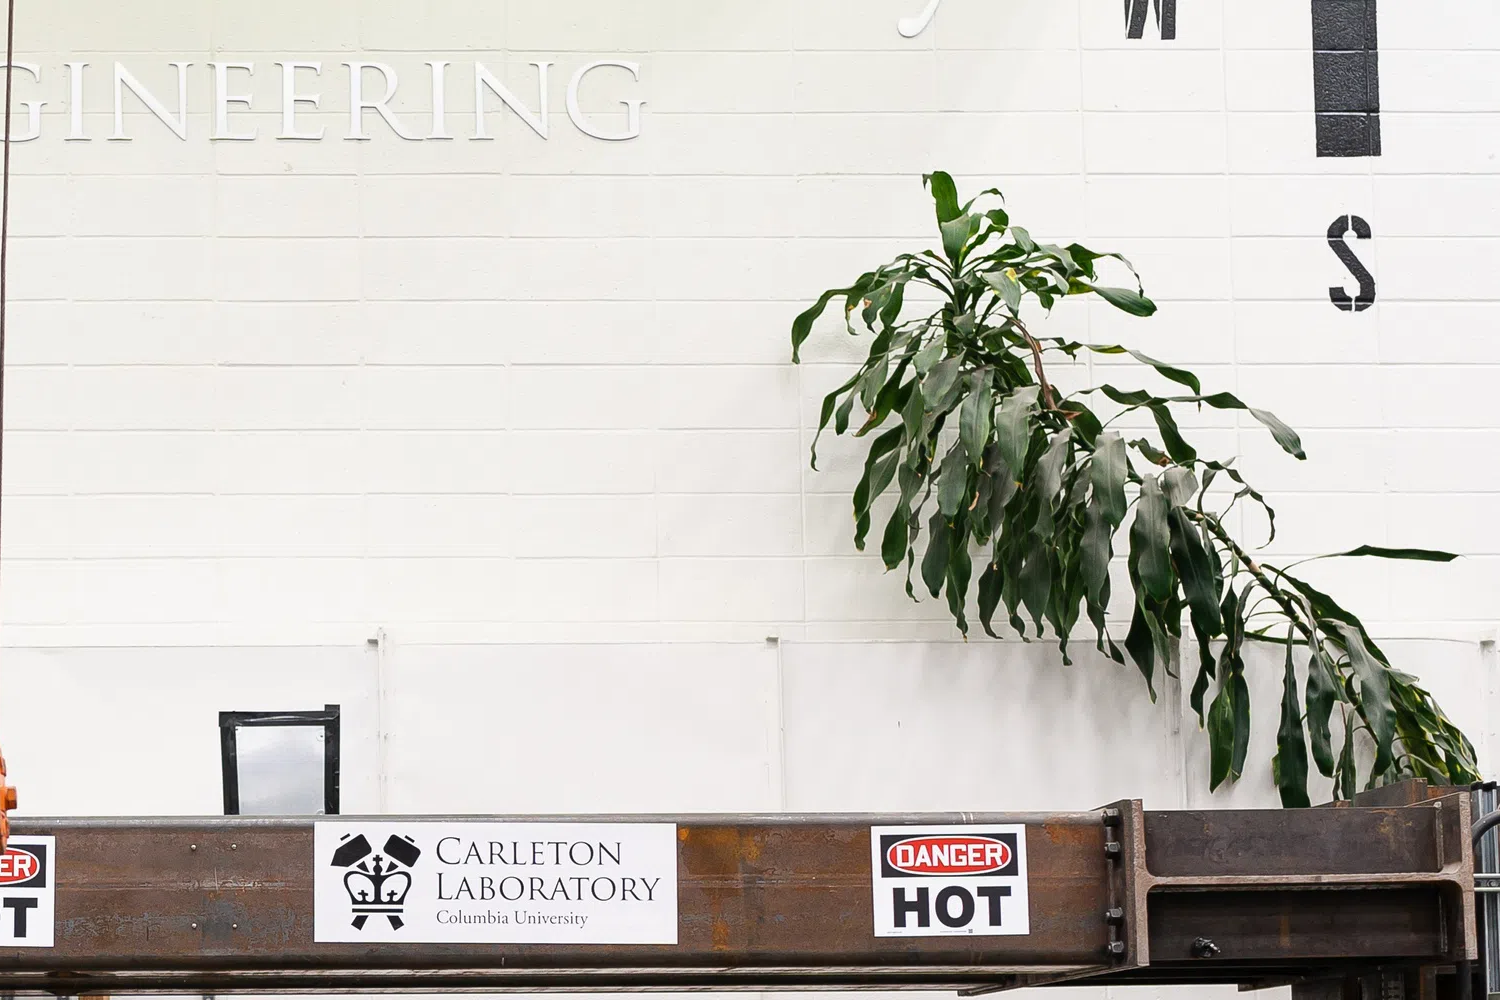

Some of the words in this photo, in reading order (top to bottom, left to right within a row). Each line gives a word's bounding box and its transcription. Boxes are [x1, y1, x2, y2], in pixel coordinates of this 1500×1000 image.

[1326, 214, 1376, 312] S
[436, 837, 622, 866] CARLETON
[896, 844, 1003, 867] DANGER
[436, 872, 661, 902] LABORATORY
[436, 910, 509, 925] Columbia
[514, 910, 589, 929] University
[893, 886, 1011, 928] HOT
